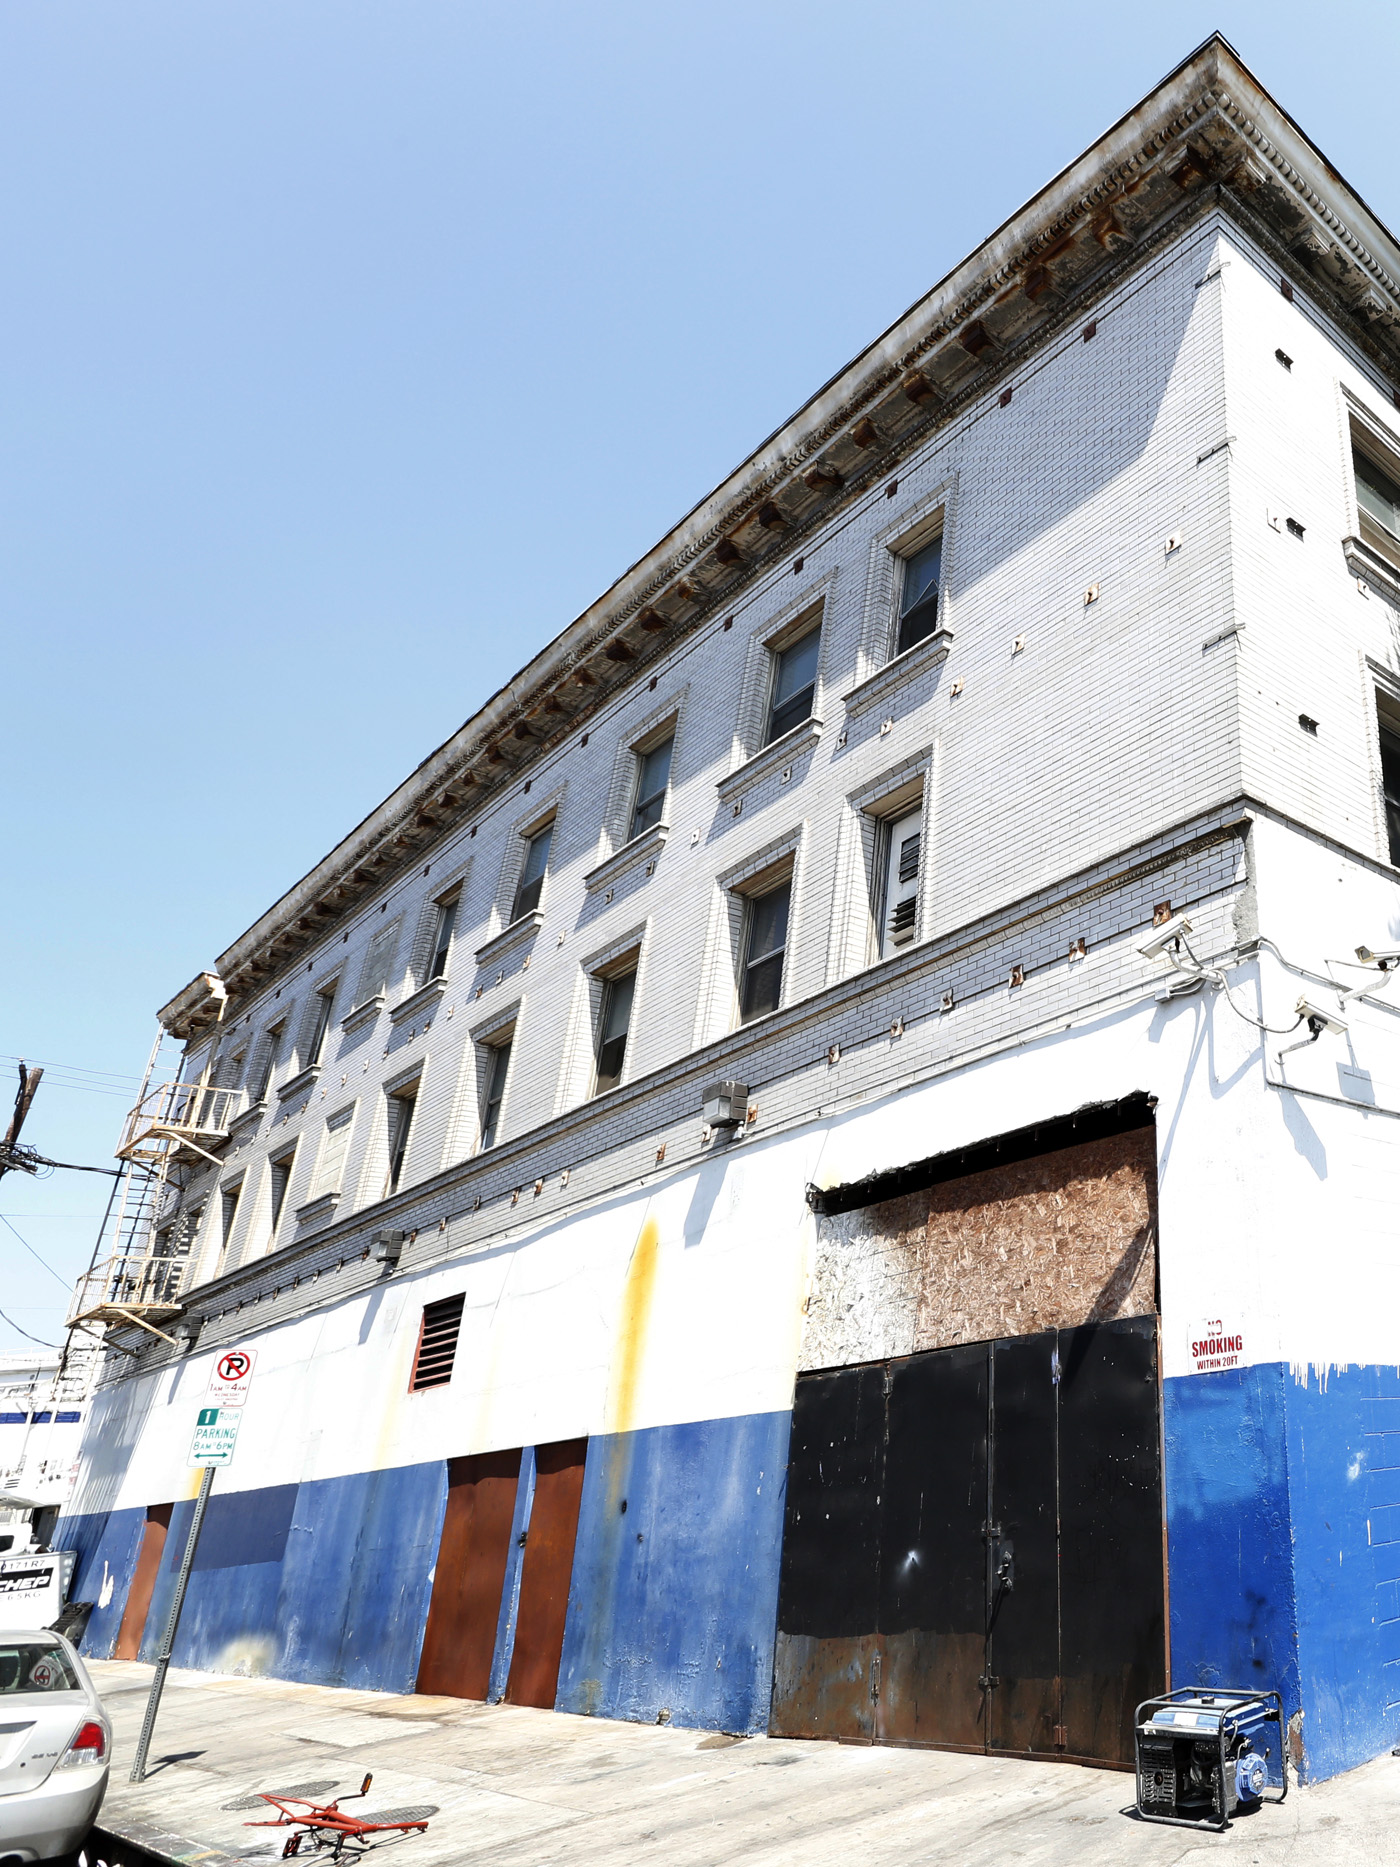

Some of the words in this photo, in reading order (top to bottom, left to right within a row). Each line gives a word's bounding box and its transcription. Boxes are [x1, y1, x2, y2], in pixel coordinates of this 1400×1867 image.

[1192, 1335, 1243, 1357] SMOKING
[1197, 1358, 1221, 1370] WITHIN
[1222, 1355, 1238, 1367] 20FT
[210, 1383, 223, 1391] 1AM
[231, 1383, 247, 1391] 4AM
[204, 1410, 212, 1424] 1
[218, 1412, 239, 1420] HOUR
[195, 1428, 236, 1439] PARKING
[193, 1441, 211, 1450] 8AM
[216, 1440, 233, 1450] 6PM
